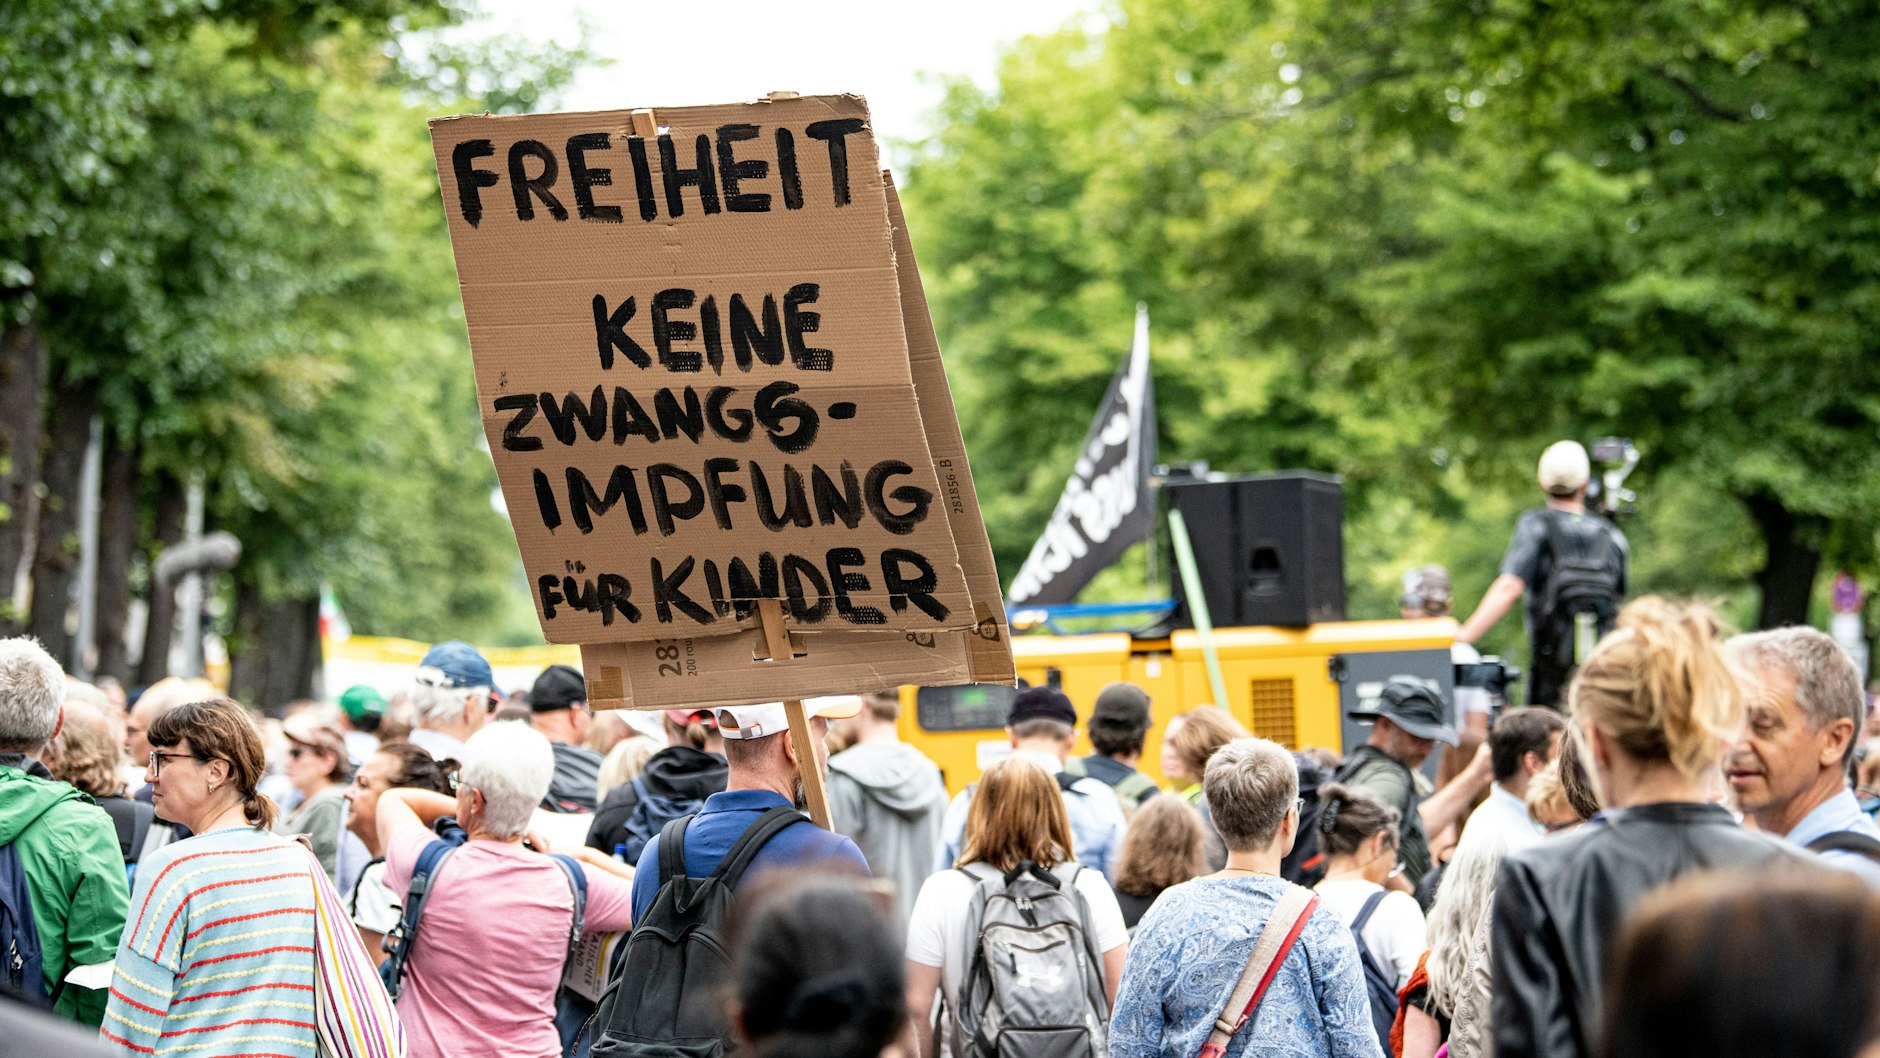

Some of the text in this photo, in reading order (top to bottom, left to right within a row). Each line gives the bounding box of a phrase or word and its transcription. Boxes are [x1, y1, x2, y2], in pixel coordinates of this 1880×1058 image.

[452, 117, 868, 229] FREIHEIT
[592, 283, 834, 375] KEINE
[533, 458, 933, 537] IMPFUNG
[538, 547, 951, 627] FÜR KINDER
[654, 638, 682, 677] 28
[684, 638, 698, 677] 200 rou
